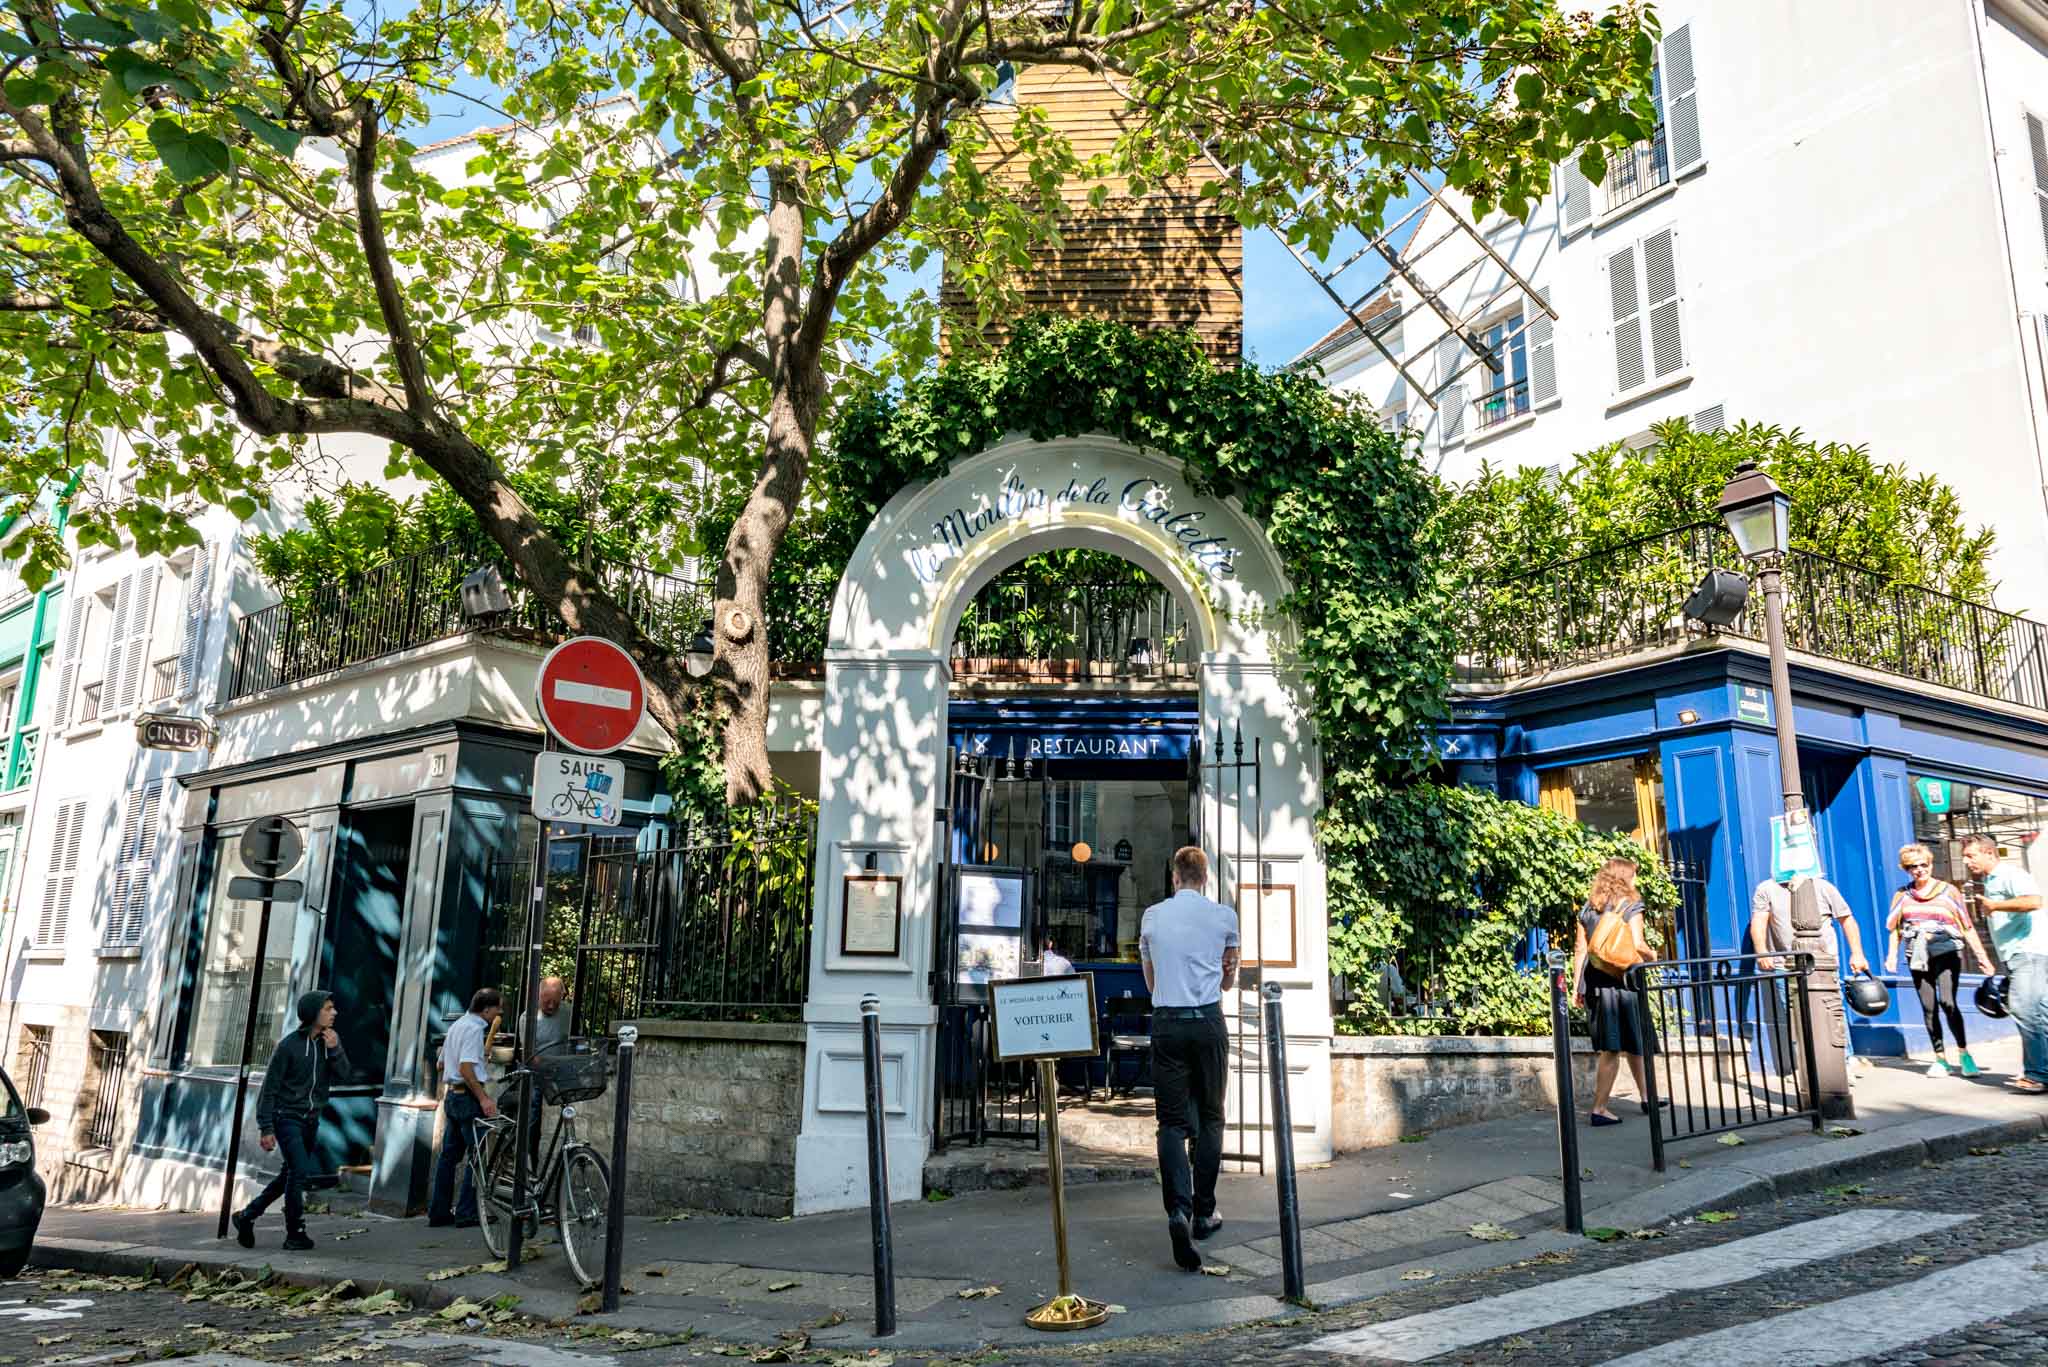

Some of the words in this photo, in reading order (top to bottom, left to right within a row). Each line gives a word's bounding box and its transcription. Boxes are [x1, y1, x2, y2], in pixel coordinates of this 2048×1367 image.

[911, 548, 943, 583] le
[934, 476, 1046, 548] Moulin
[1057, 478, 1082, 504] de
[1086, 477, 1110, 504] la
[1121, 479, 1235, 582] Galette
[185, 727, 199, 747] 13
[1030, 738, 1160, 755] RESTAURANT
[1014, 1012, 1074, 1025] VOITURIER
